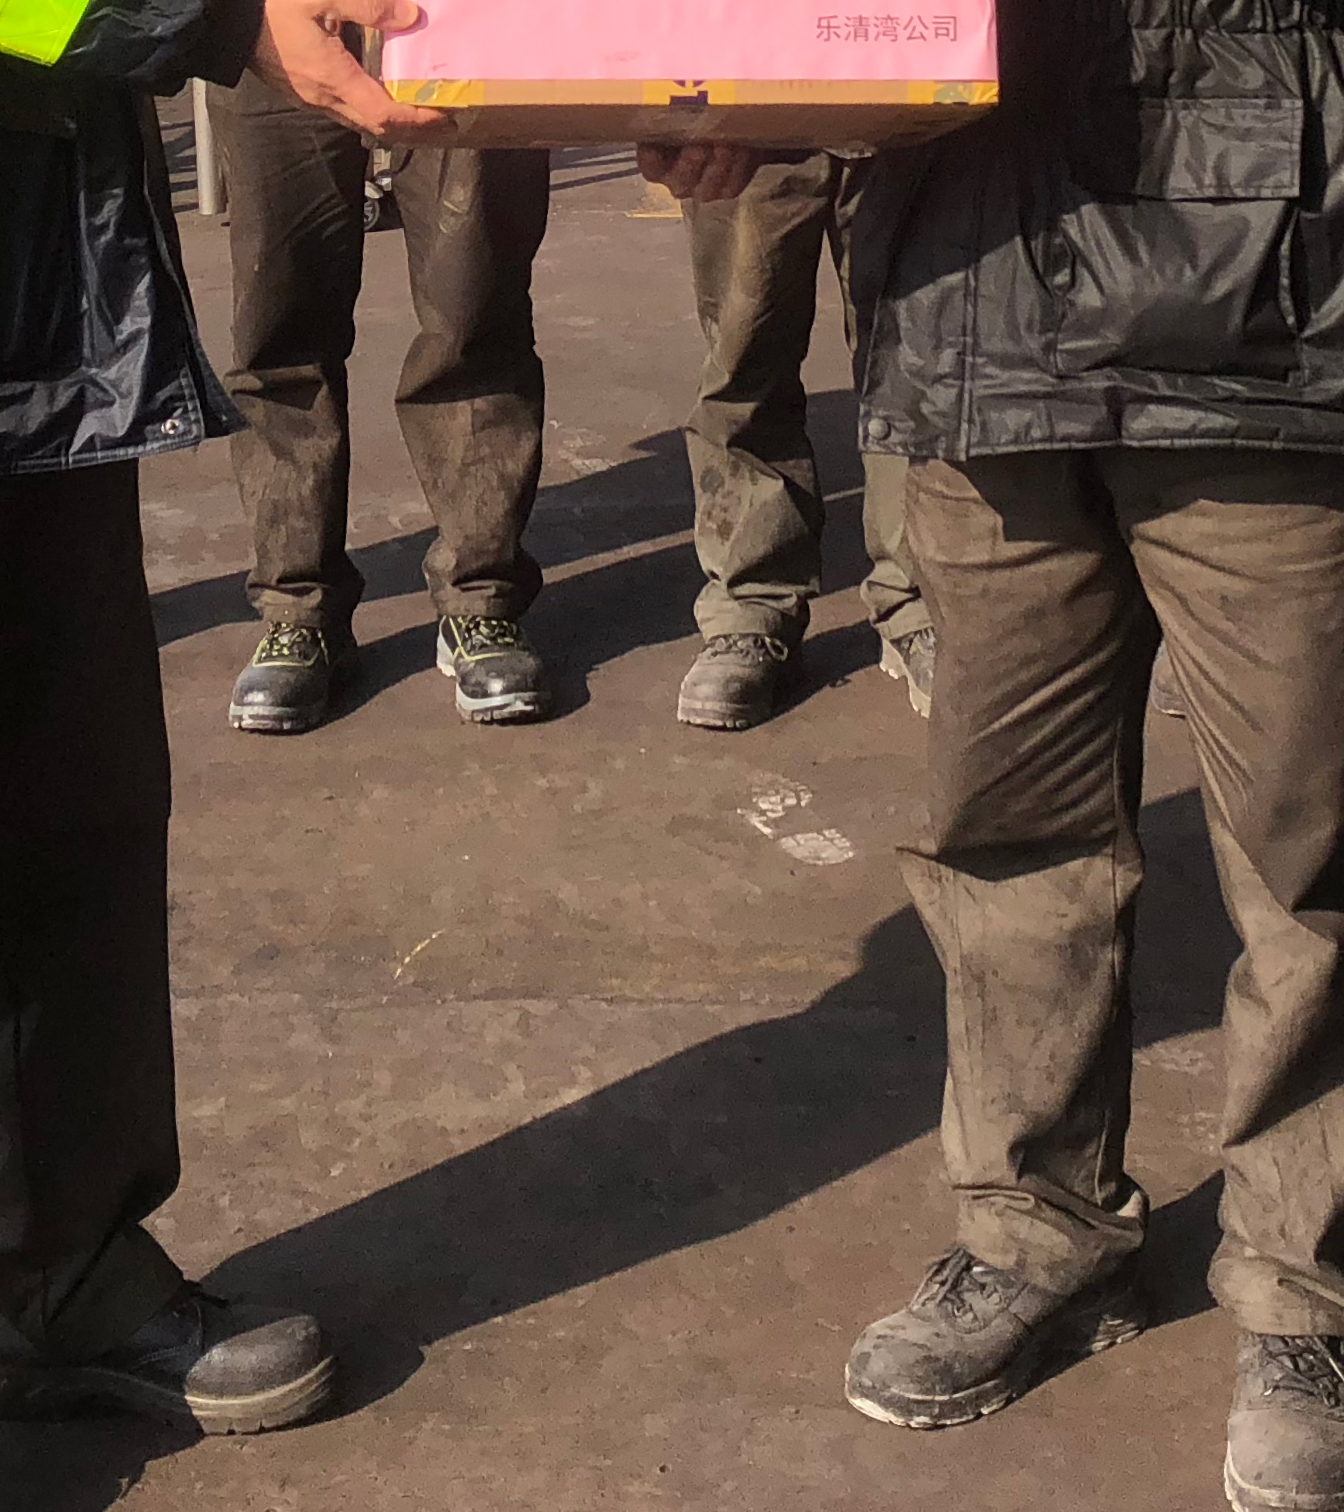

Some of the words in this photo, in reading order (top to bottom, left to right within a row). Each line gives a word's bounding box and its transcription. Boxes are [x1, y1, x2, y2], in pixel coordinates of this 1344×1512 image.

[815, 14, 958, 42] 乐清湾公司
